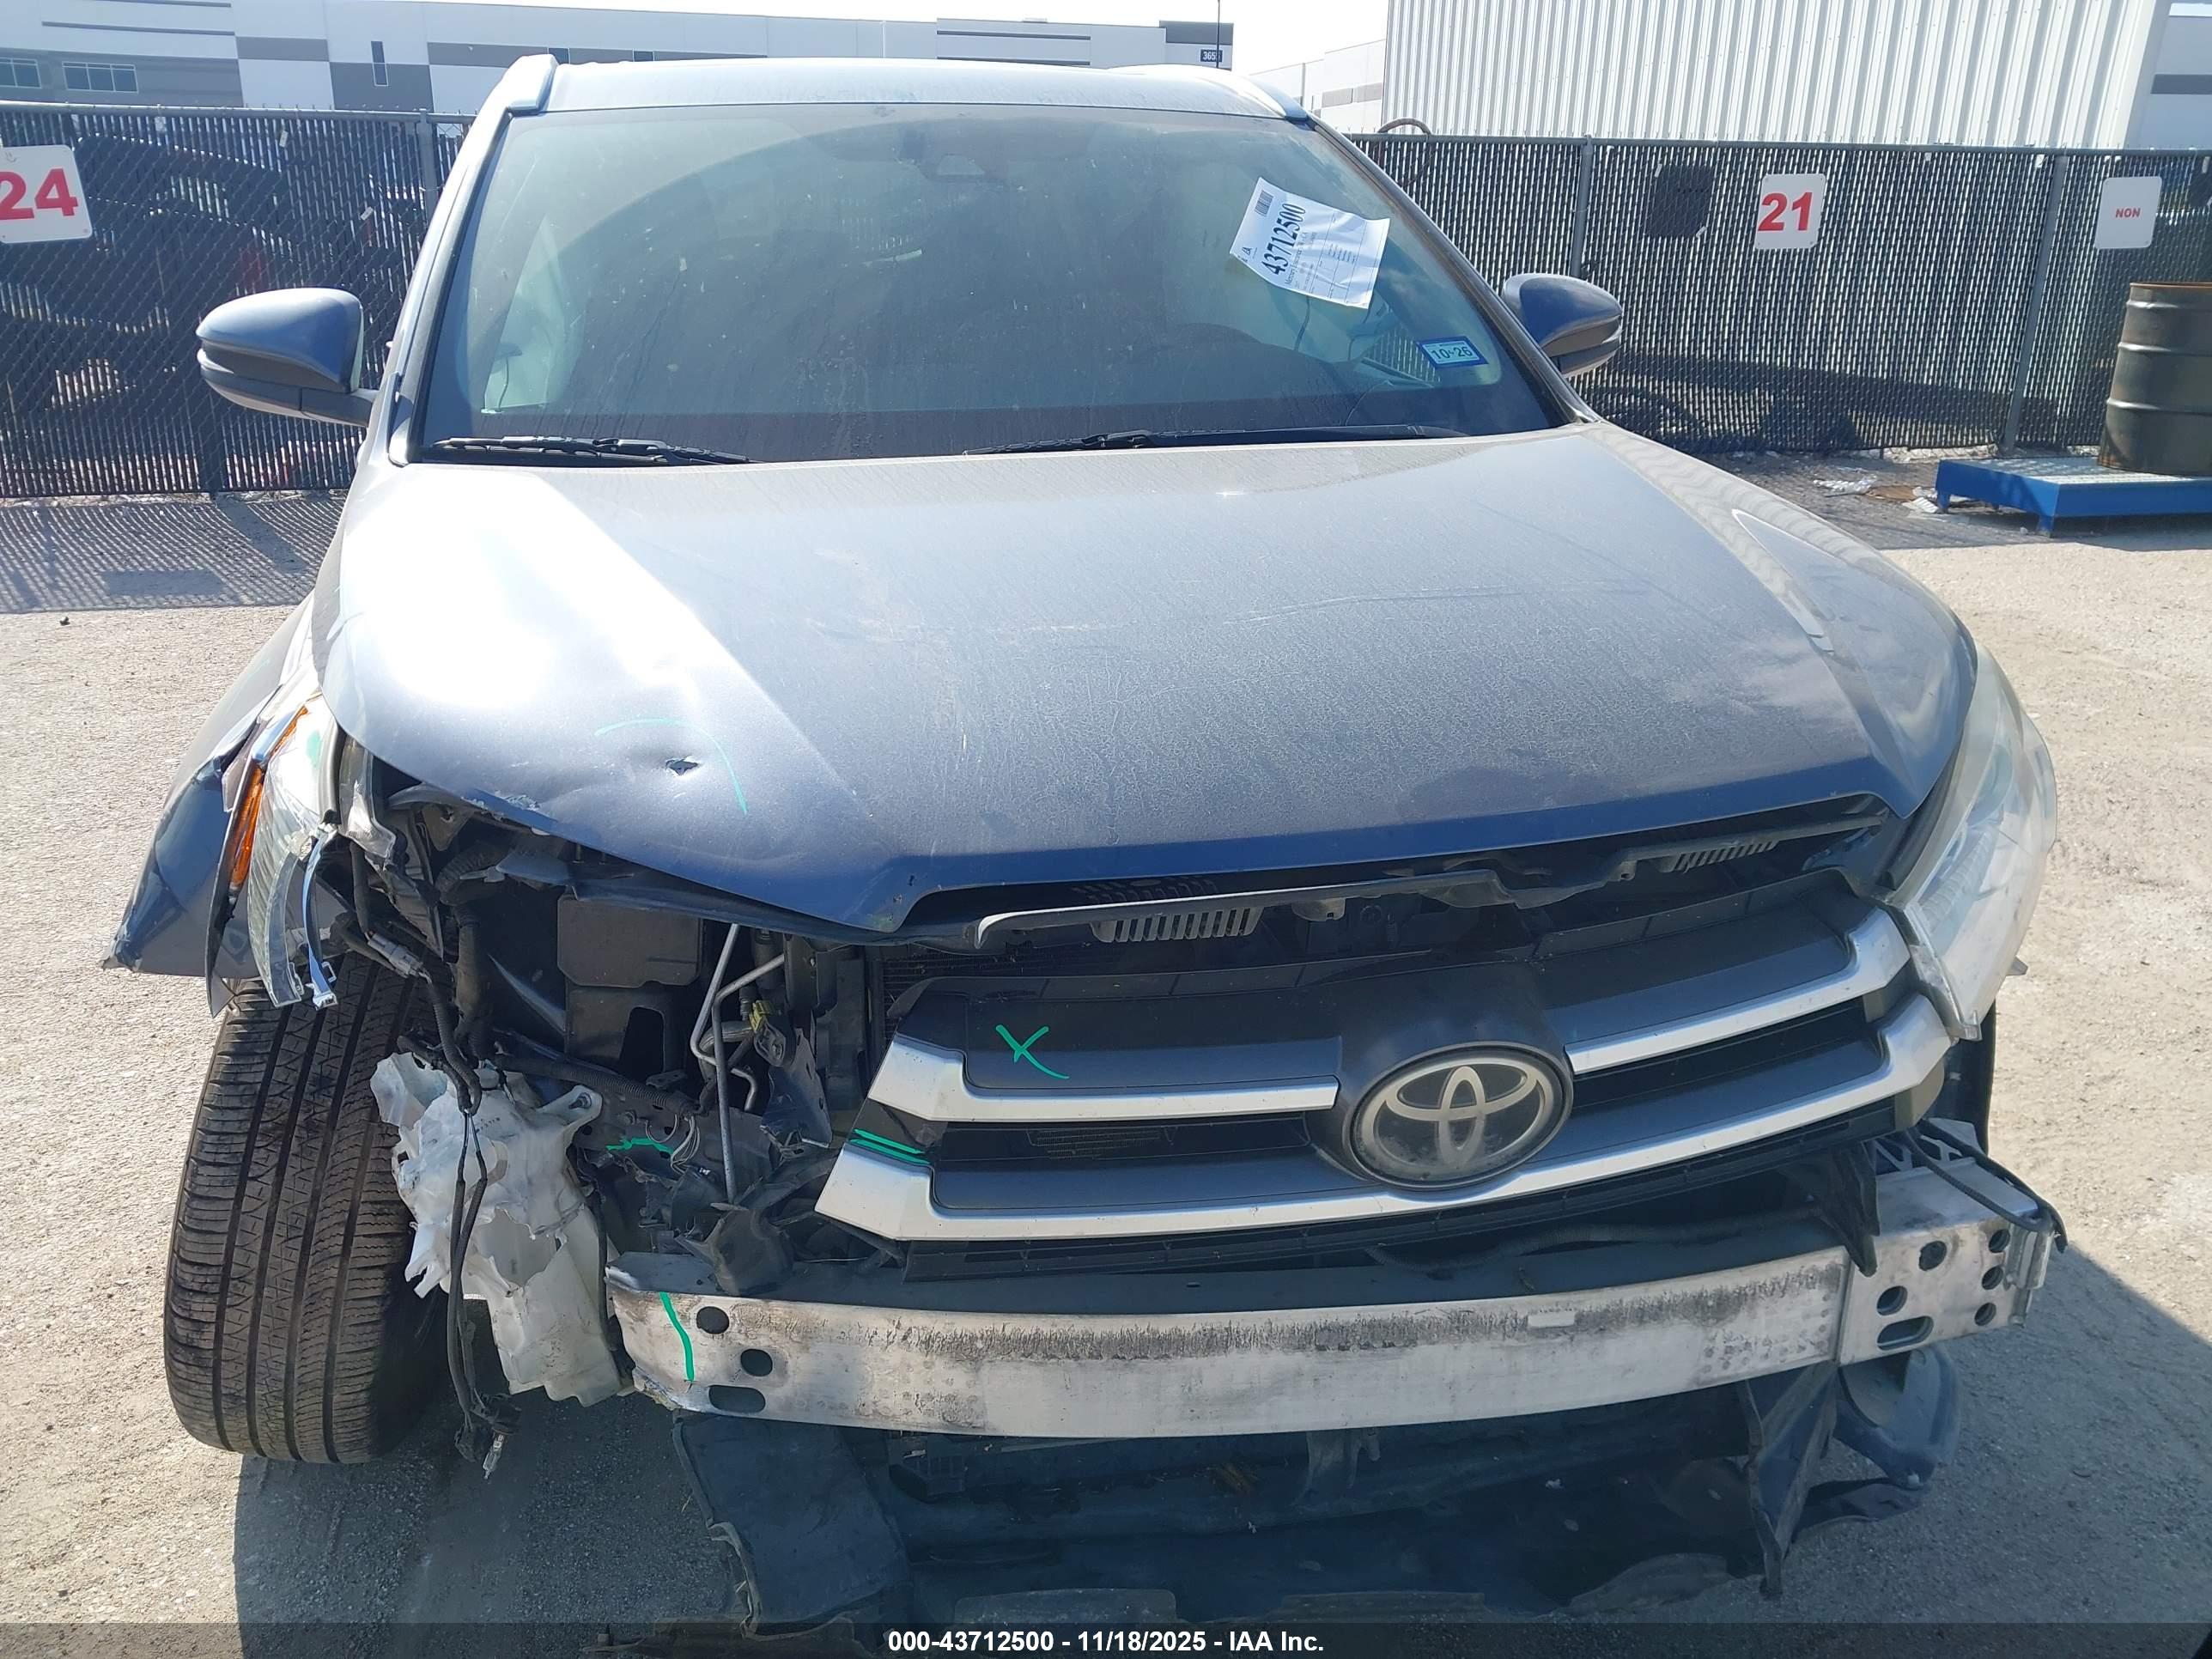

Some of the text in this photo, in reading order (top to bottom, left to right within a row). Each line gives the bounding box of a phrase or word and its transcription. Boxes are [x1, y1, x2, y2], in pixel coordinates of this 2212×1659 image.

[0, 168, 78, 220] 24
[1758, 192, 1813, 231] 21
[2115, 208, 2141, 217] NON
[1261, 204, 1305, 275] 43712500
